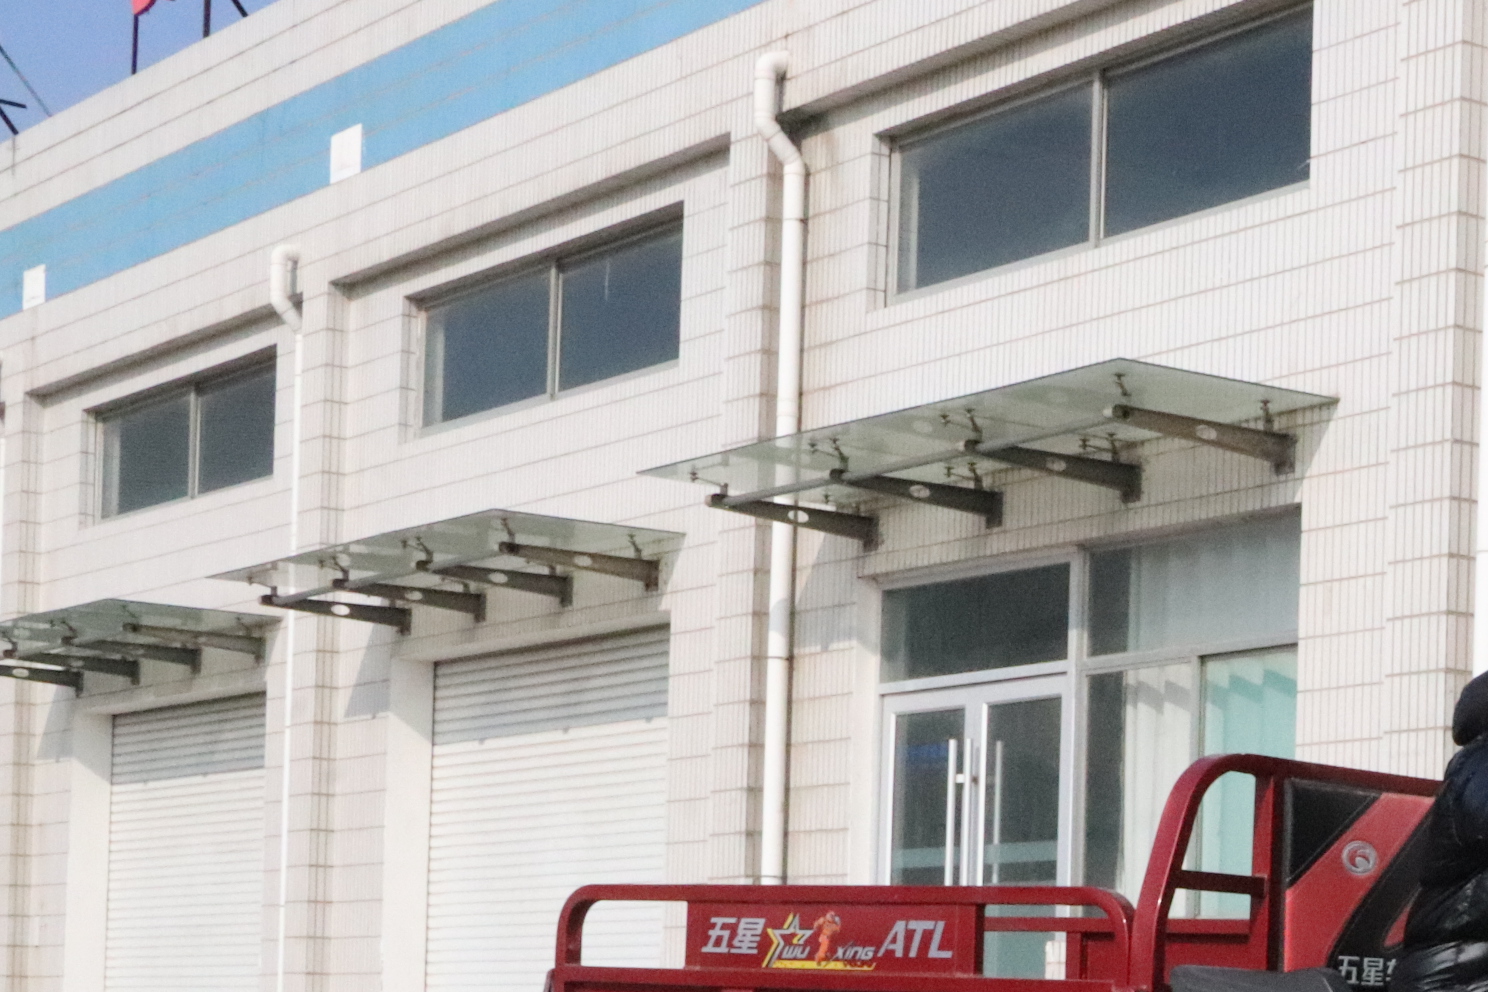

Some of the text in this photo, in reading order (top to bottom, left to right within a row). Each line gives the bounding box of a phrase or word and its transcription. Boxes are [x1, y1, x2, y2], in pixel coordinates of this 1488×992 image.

[701, 916, 766, 955] 五星
[877, 920, 953, 959] ATL
[1338, 955, 1397, 986] 五星
